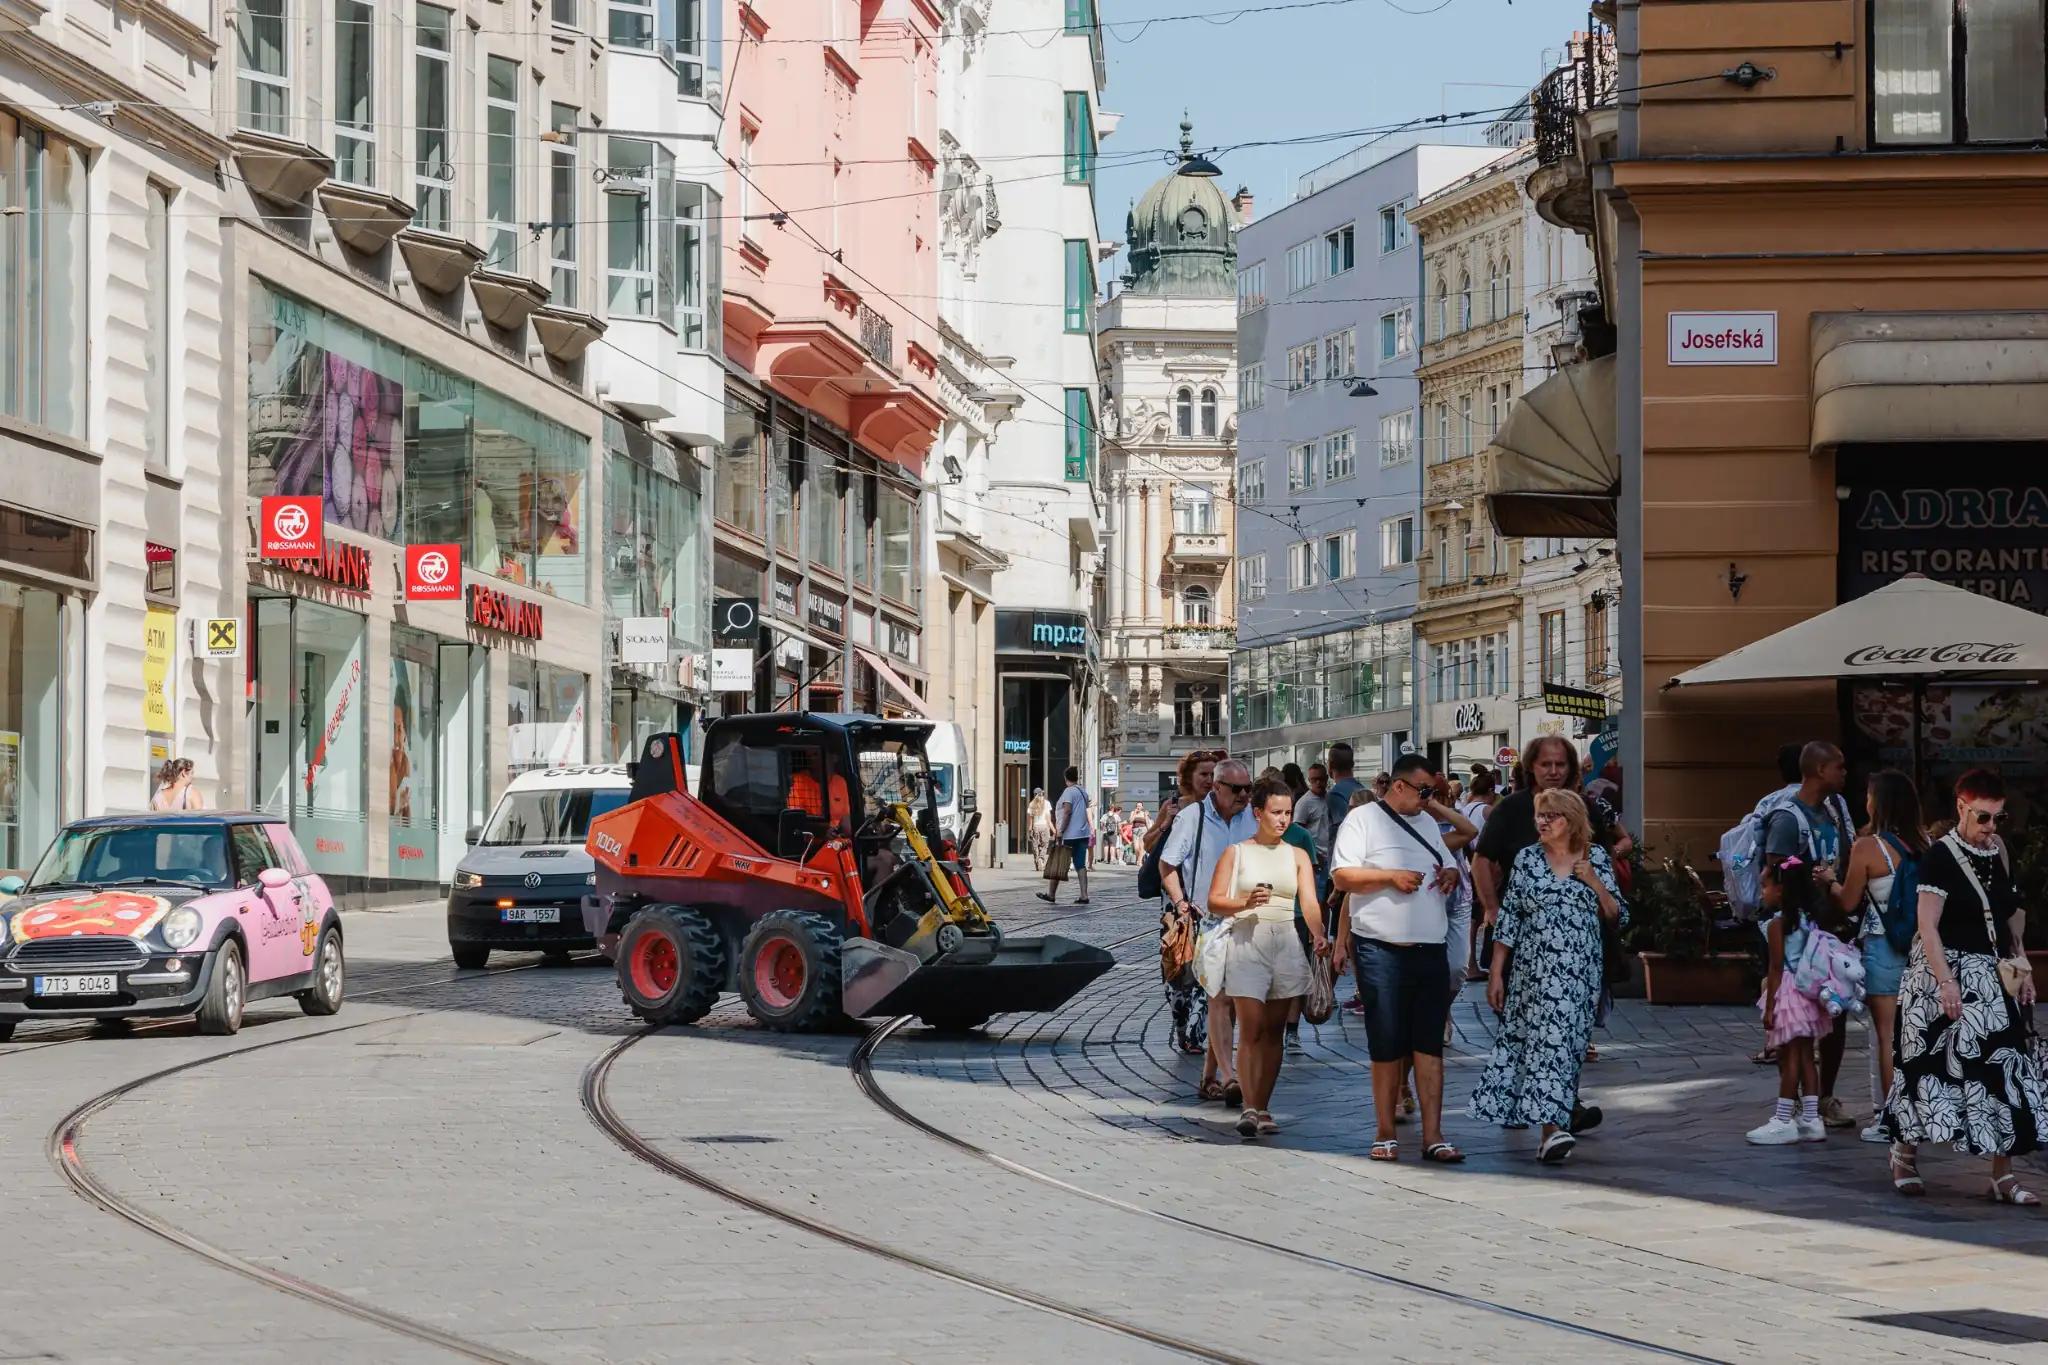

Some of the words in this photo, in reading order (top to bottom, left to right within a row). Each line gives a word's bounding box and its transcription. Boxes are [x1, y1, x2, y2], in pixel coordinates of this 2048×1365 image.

[1682, 328, 1764, 349] Josefská
[1856, 487, 2048, 530] ADRIA
[267, 541, 316, 550] ROSSMANN
[411, 584, 455, 593] ROSSMANN
[472, 584, 543, 640] ROSSMANN
[147, 629, 166, 649] ATM
[1033, 623, 1086, 647] mp.cz
[1546, 693, 1606, 709] EXCHANGE
[1004, 739, 1031, 752] mp.cz
[1499, 753, 1519, 763] teta
[595, 831, 623, 857] 1004
[734, 859, 751, 871] WAY
[508, 909, 526, 920] 9AR
[533, 909, 556, 920] 1557
[46, 978, 69, 991] 7T3
[79, 976, 111, 991] 6048
